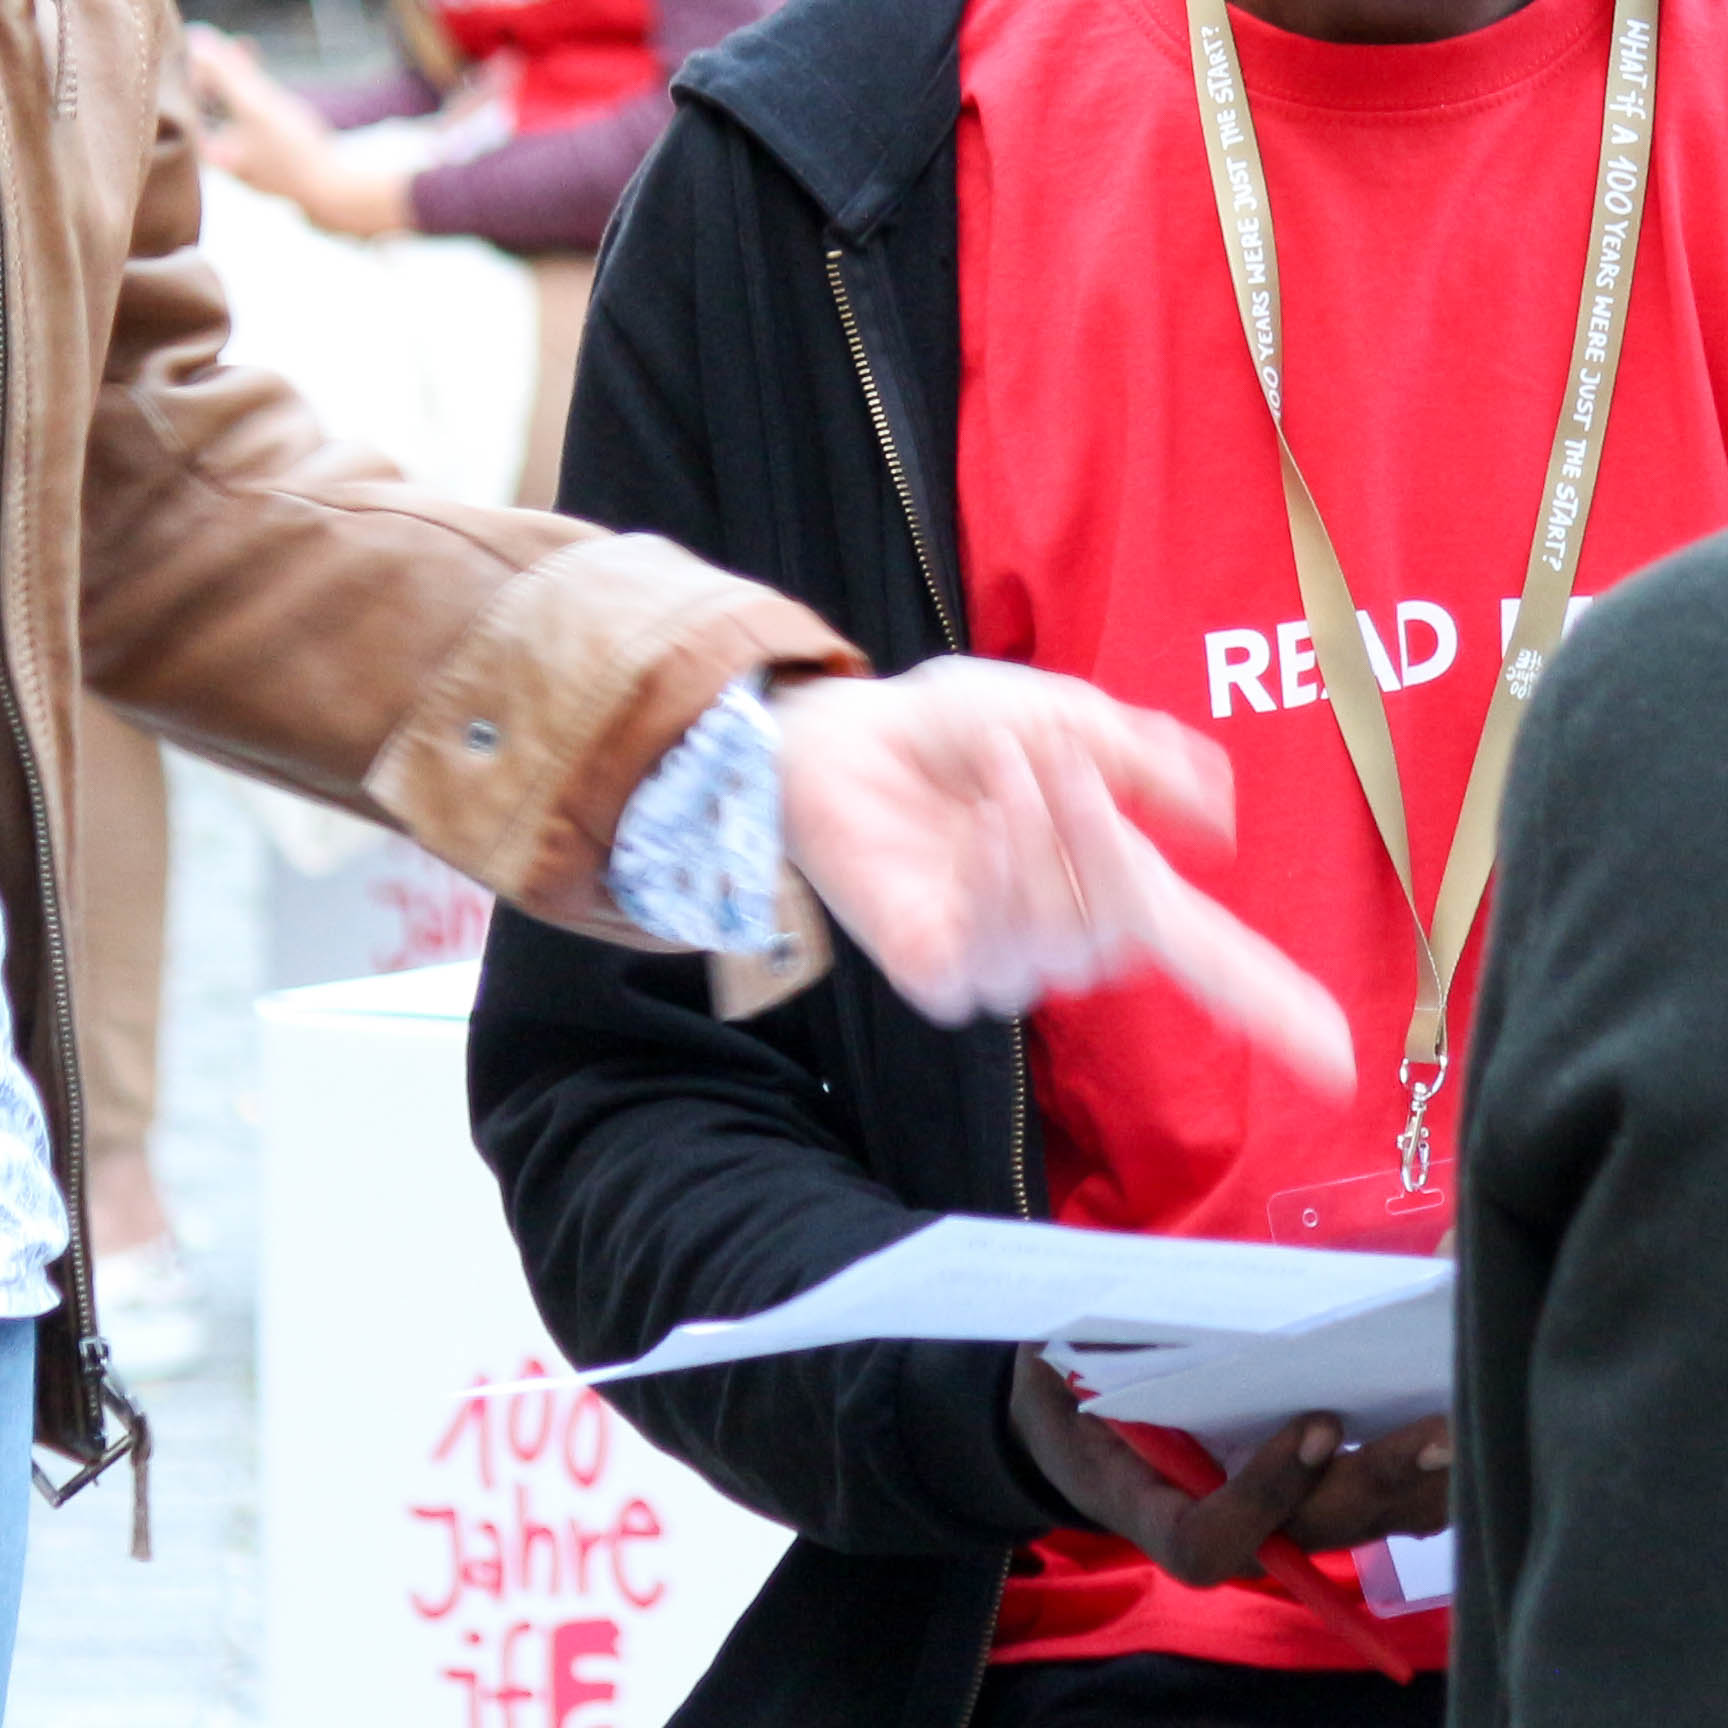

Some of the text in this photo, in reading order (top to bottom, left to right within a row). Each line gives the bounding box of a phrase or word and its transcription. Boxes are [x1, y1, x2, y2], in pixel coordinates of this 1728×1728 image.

[1201, 25, 1234, 104] START?
[1619, 18, 1650, 90] WHAT
[1217, 108, 1244, 150] THE
[1611, 124, 1639, 144] A
[1226, 156, 1258, 212] JUST
[1604, 155, 1638, 215] 100
[1237, 216, 1266, 284] WERE
[1595, 220, 1629, 290] YEARS
[1252, 290, 1274, 361] YEARS
[1585, 295, 1614, 363] WERE
[1573, 368, 1601, 432] JUST
[1562, 439, 1587, 479] THE
[1543, 482, 1579, 572] START?
[432, 1357, 610, 1488] 100
[408, 1482, 666, 1619] Jahre
